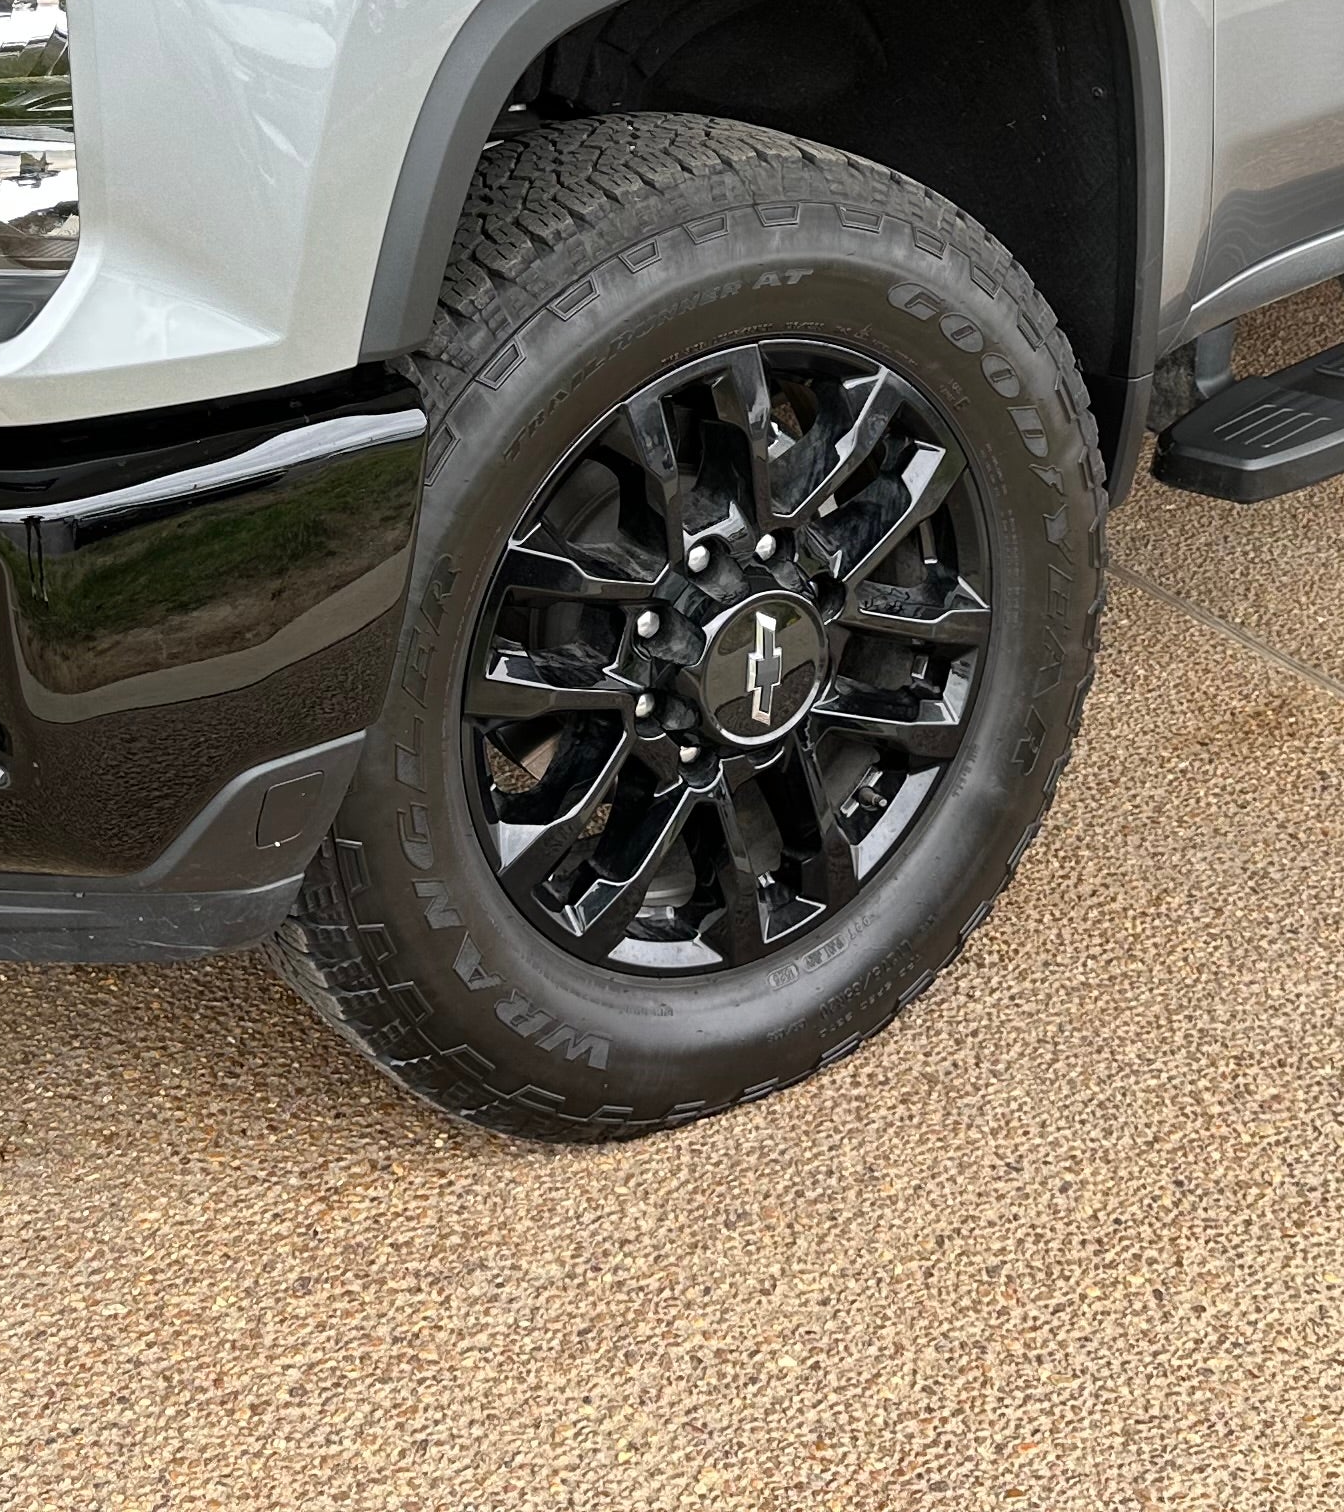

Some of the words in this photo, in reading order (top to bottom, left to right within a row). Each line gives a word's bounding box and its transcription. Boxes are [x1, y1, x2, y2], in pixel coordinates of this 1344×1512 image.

[751, 268, 816, 291] AT
[887, 280, 1072, 777] GOODYEAR
[393, 552, 613, 1071] WRANGLER
